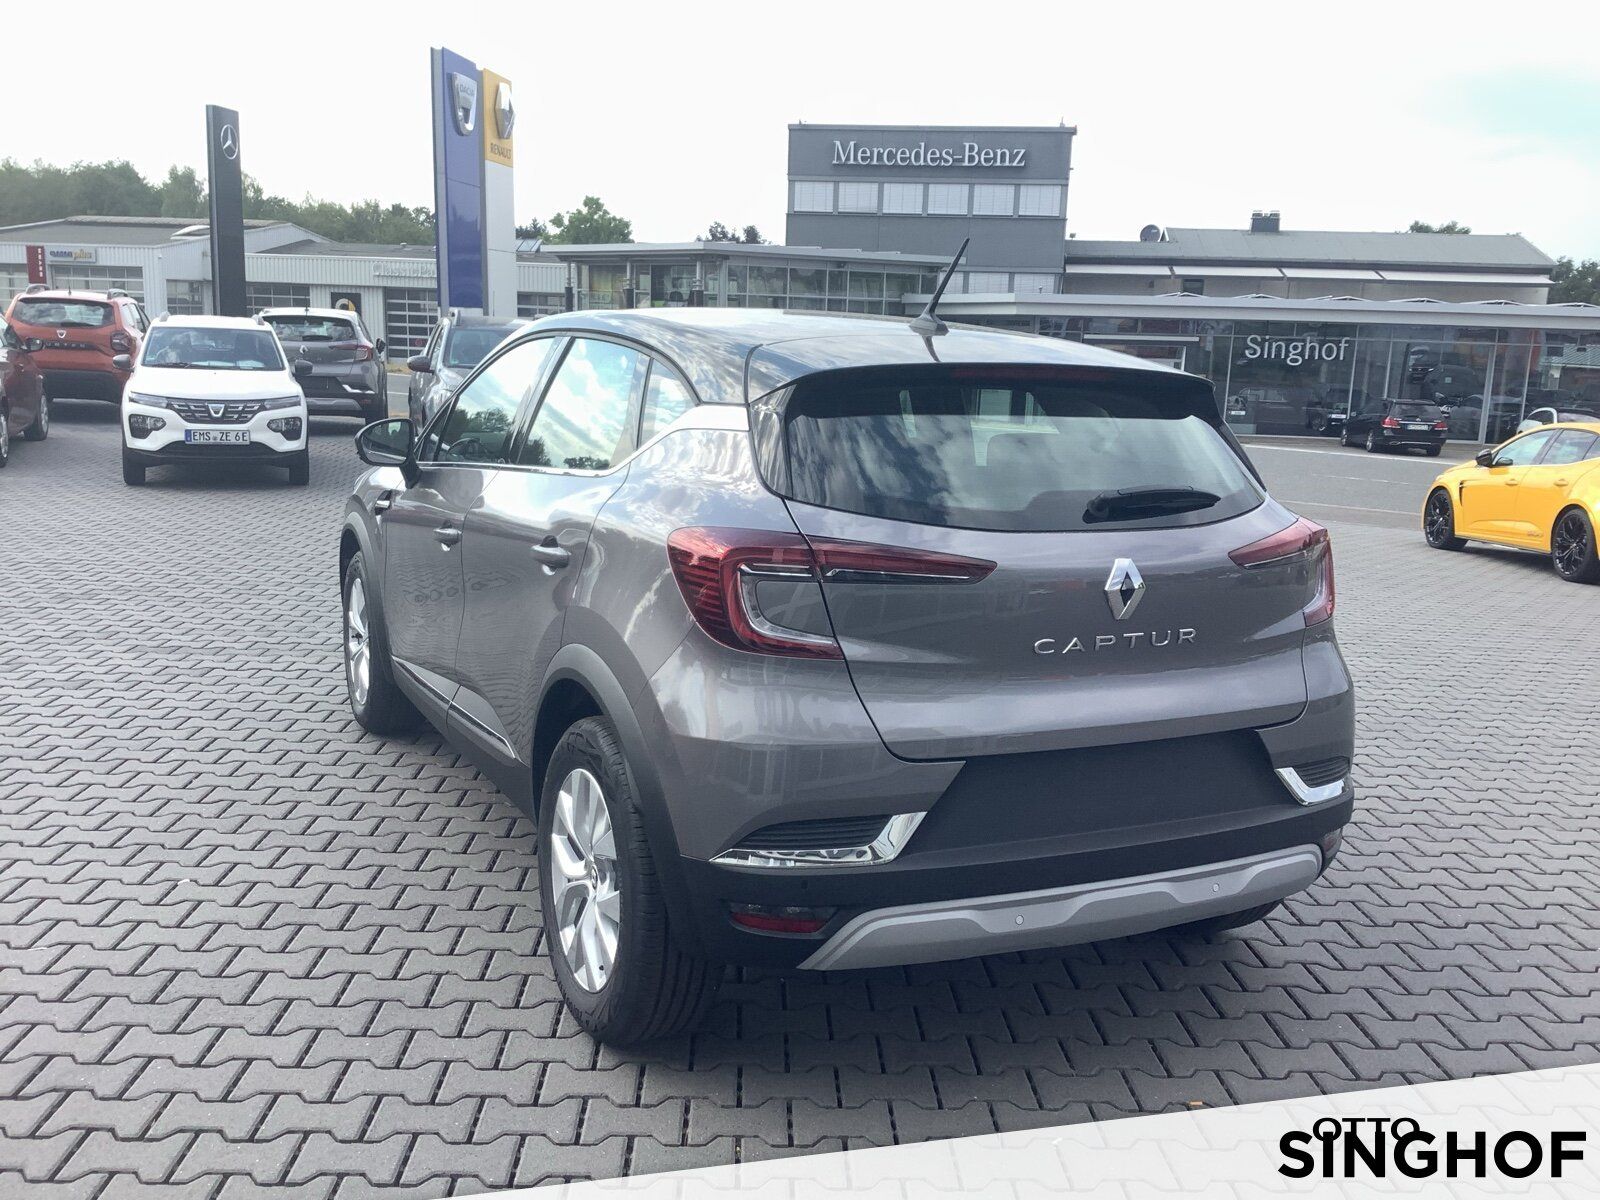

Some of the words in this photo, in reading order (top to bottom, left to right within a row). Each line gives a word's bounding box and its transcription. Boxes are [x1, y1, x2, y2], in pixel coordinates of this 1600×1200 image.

[490, 142, 512, 159] RENAULT
[832, 140, 1026, 167] Mercedes-Benz
[1244, 334, 1350, 366] Singhof
[192, 431, 211, 442] EMS
[219, 431, 231, 442] ZE
[1033, 628, 1197, 655] CAPTUR
